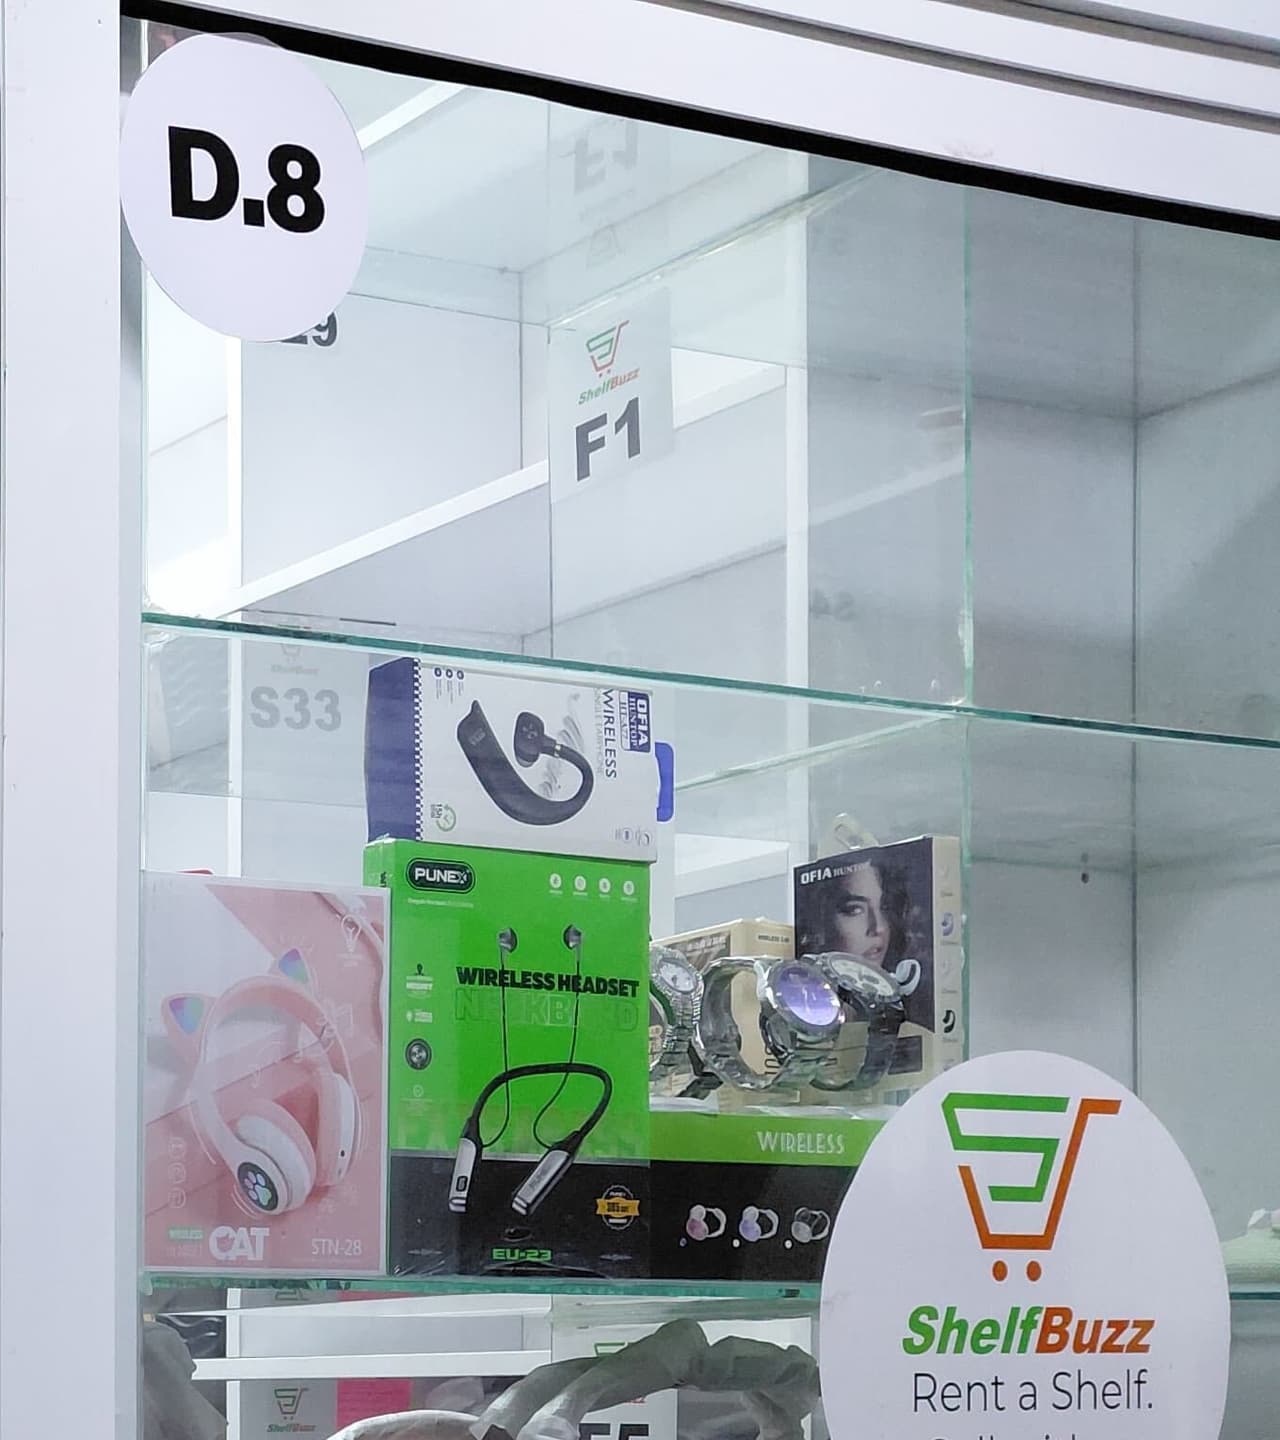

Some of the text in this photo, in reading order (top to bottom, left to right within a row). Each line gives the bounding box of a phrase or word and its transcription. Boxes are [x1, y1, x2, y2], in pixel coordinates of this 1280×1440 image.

[168, 126, 326, 234] D.8
[578, 367, 640, 406] ShelfBuzz
[574, 397, 641, 483] F1
[251, 686, 340, 731] S33
[637, 699, 648, 745] OFIA
[602, 689, 616, 778] WIRELESS
[414, 867, 469, 885] PUNEX
[457, 966, 639, 998] WIRELESS HEADSET
[757, 1131, 846, 1154] WIRELESS
[209, 1226, 270, 1260] CAT
[310, 1238, 362, 1256] STN-28
[492, 1248, 553, 1261] EU-23
[901, 1306, 1156, 1355] ShelfBuzz
[913, 1368, 1153, 1413] Rent a Shelf.
